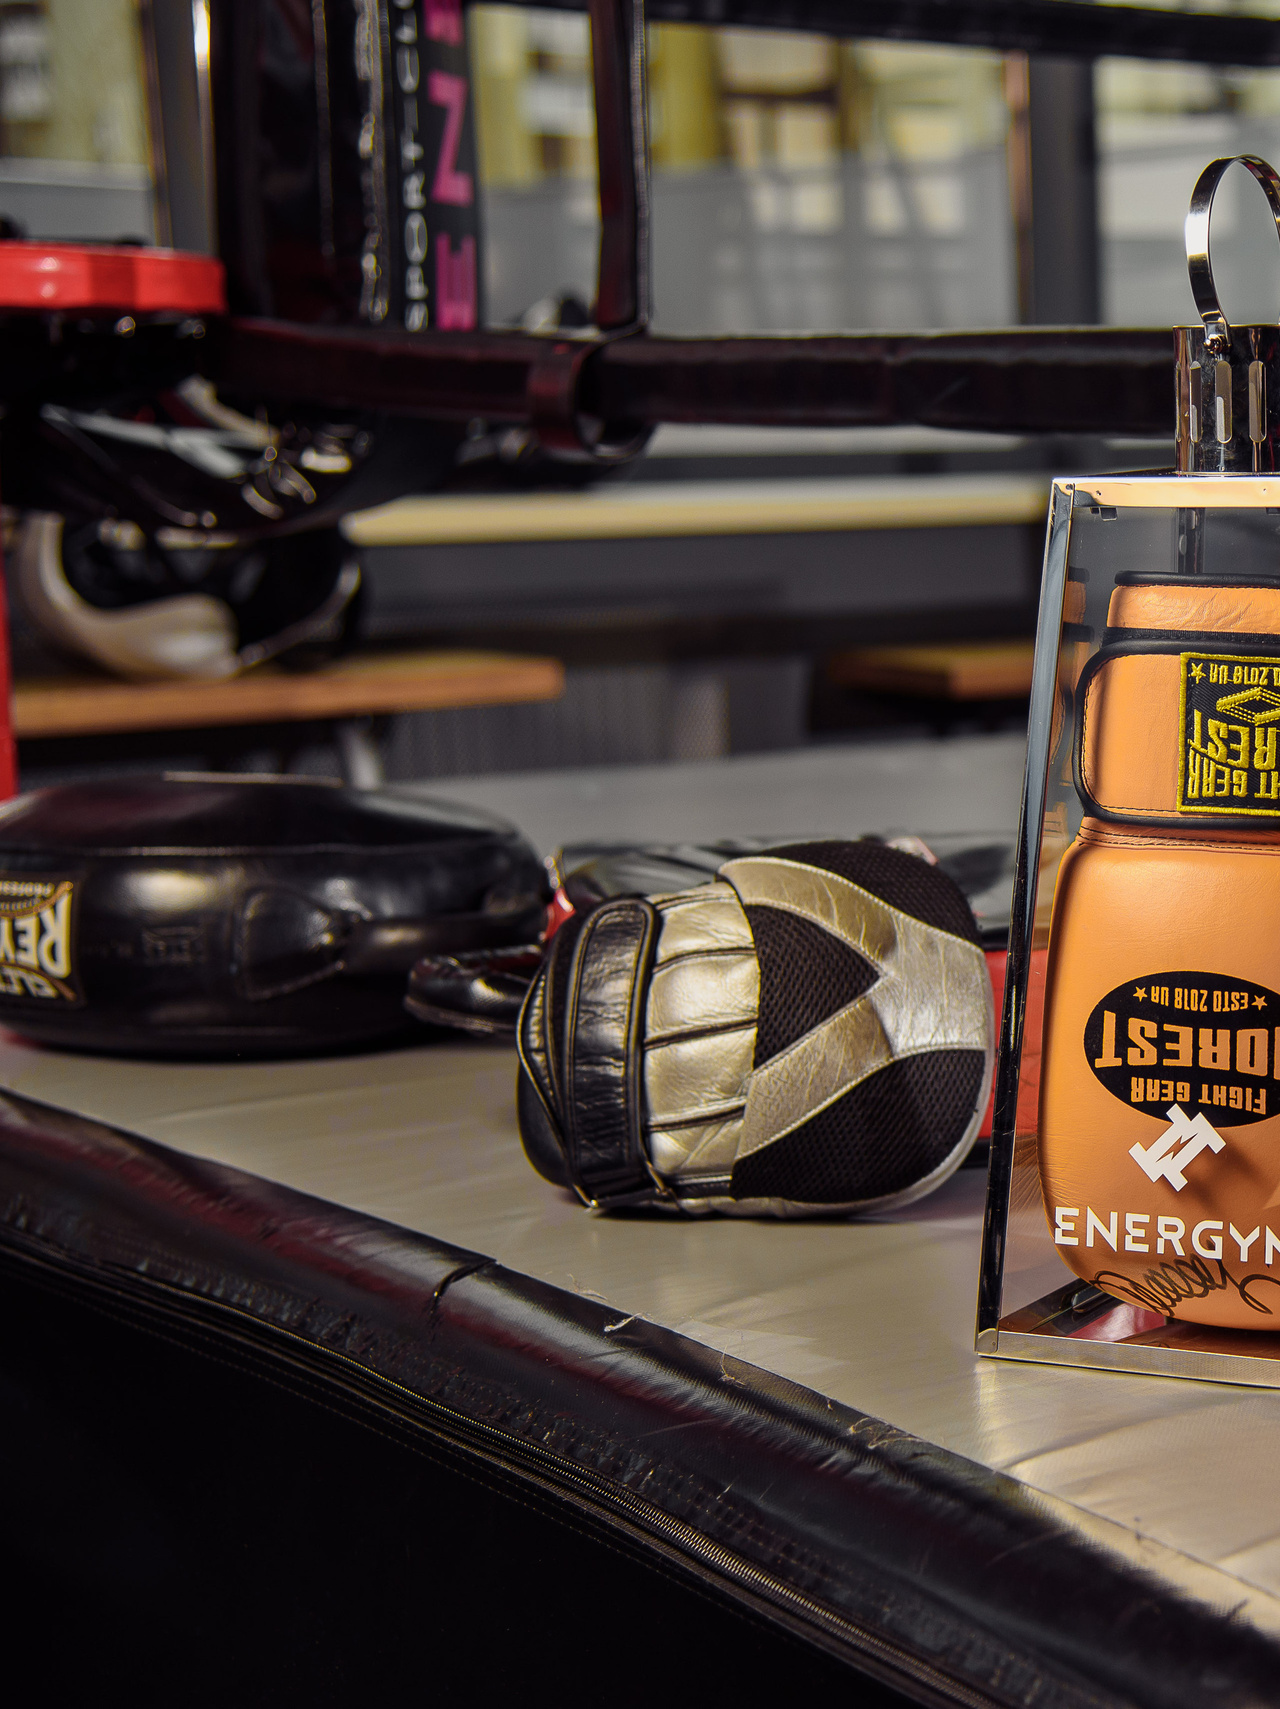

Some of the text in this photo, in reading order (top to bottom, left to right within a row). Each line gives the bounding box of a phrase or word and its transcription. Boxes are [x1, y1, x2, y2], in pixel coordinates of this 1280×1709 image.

[1209, 663, 1228, 685] UA
[1233, 665, 1269, 686] 2018
[1187, 748, 1248, 799] GEAR
[1150, 985, 1249, 1012] ESTD 2018 UA
[1130, 1076, 1267, 1115] FIGHT GEAR
